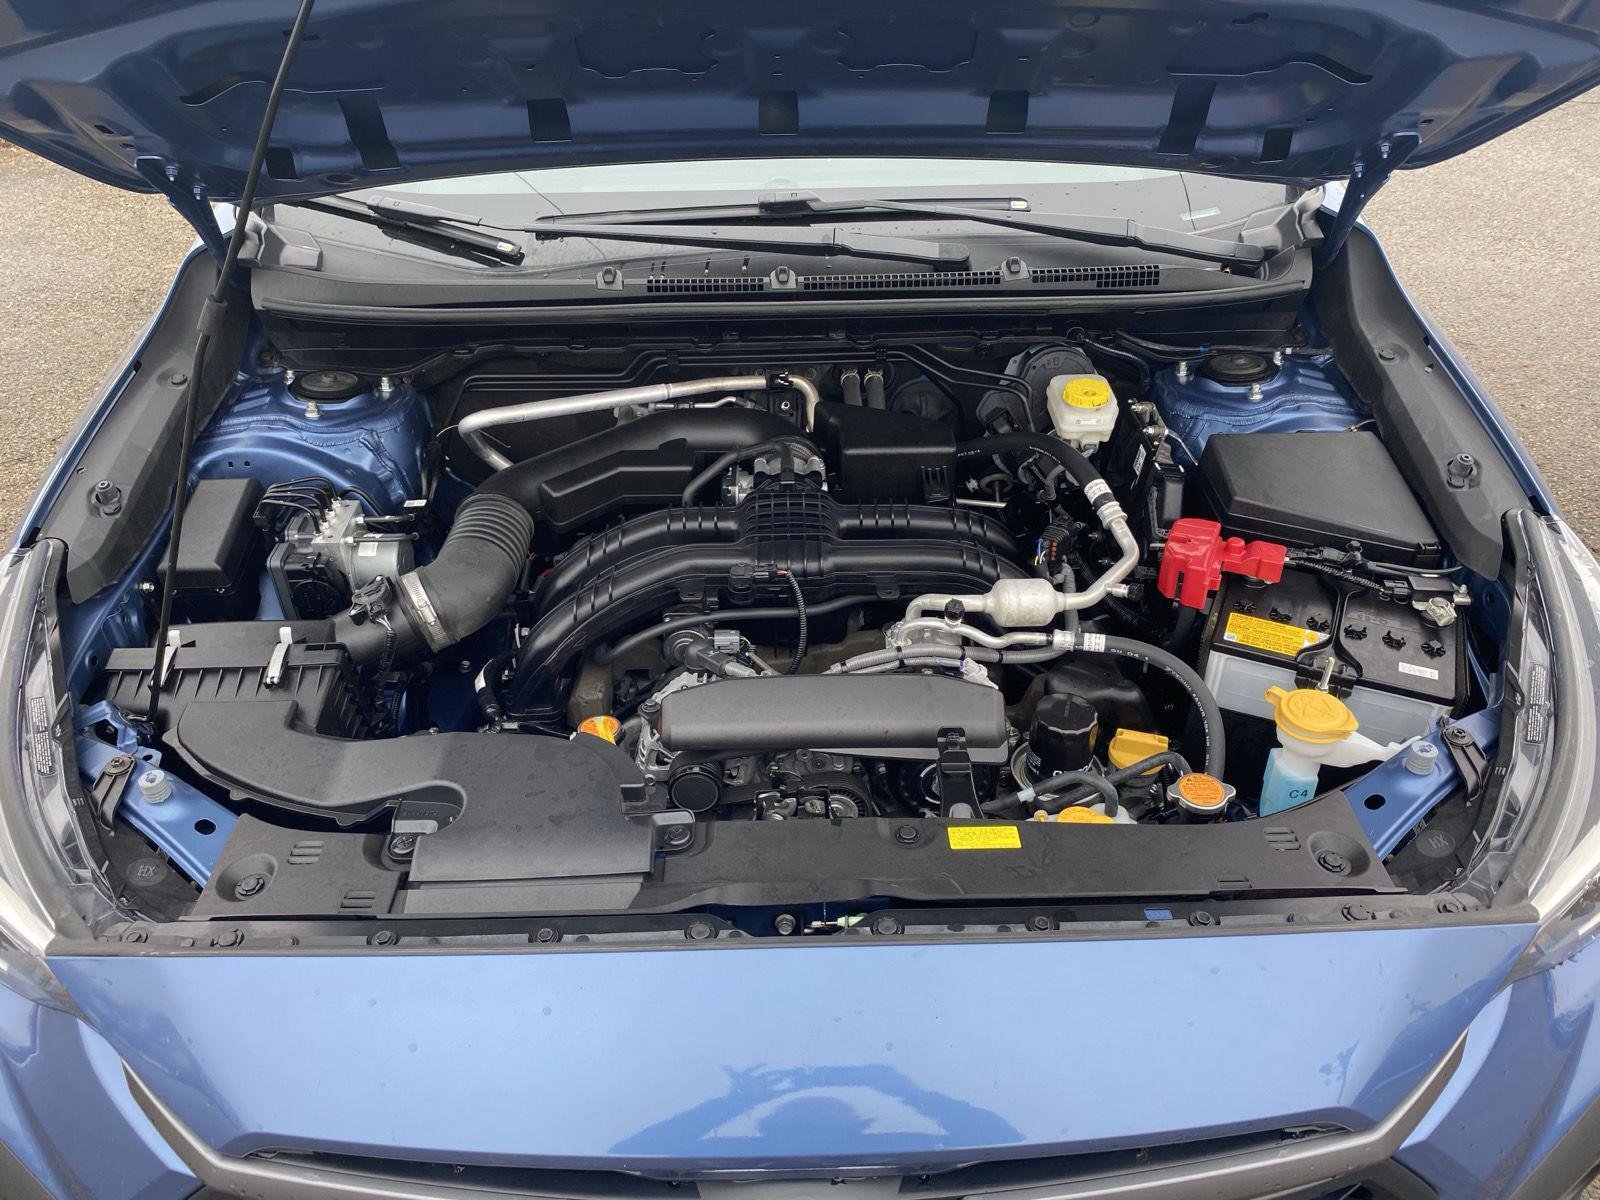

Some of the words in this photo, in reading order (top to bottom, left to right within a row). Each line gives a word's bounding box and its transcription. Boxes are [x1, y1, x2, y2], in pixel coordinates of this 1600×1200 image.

[1289, 789, 1308, 799] C4
[1428, 834, 1449, 849] HX
[137, 864, 156, 877] HX
